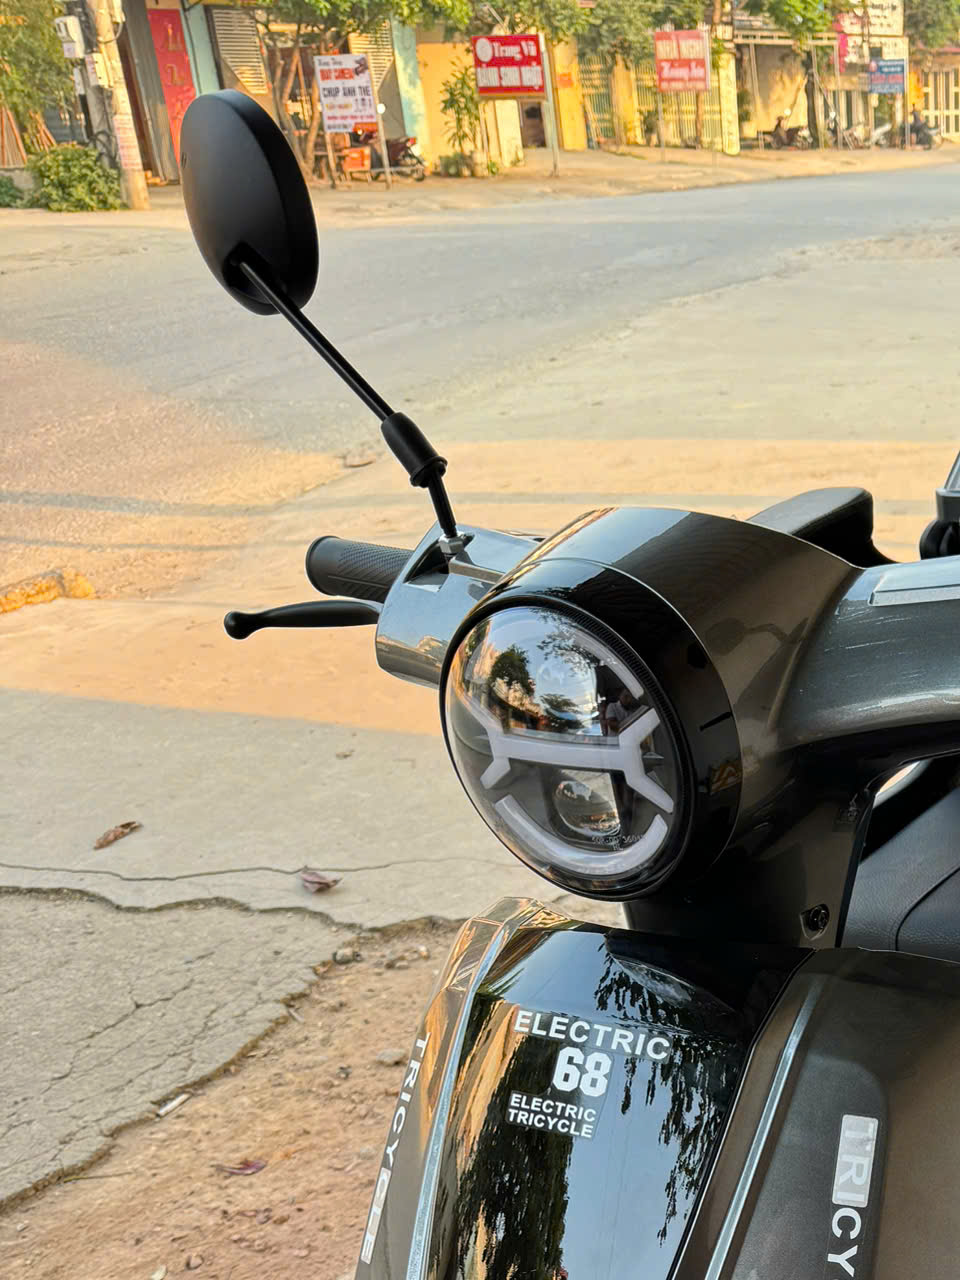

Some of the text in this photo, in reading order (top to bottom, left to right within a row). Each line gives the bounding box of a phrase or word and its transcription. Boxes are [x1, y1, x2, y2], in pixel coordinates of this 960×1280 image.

[513, 1009, 671, 1060] ELECTRIC
[552, 1046, 612, 1097] 68
[508, 1109, 595, 1138] TRICYCLE
[509, 1094, 597, 1122] ELECTRIC
[361, 1031, 431, 1264] TRICYCLE
